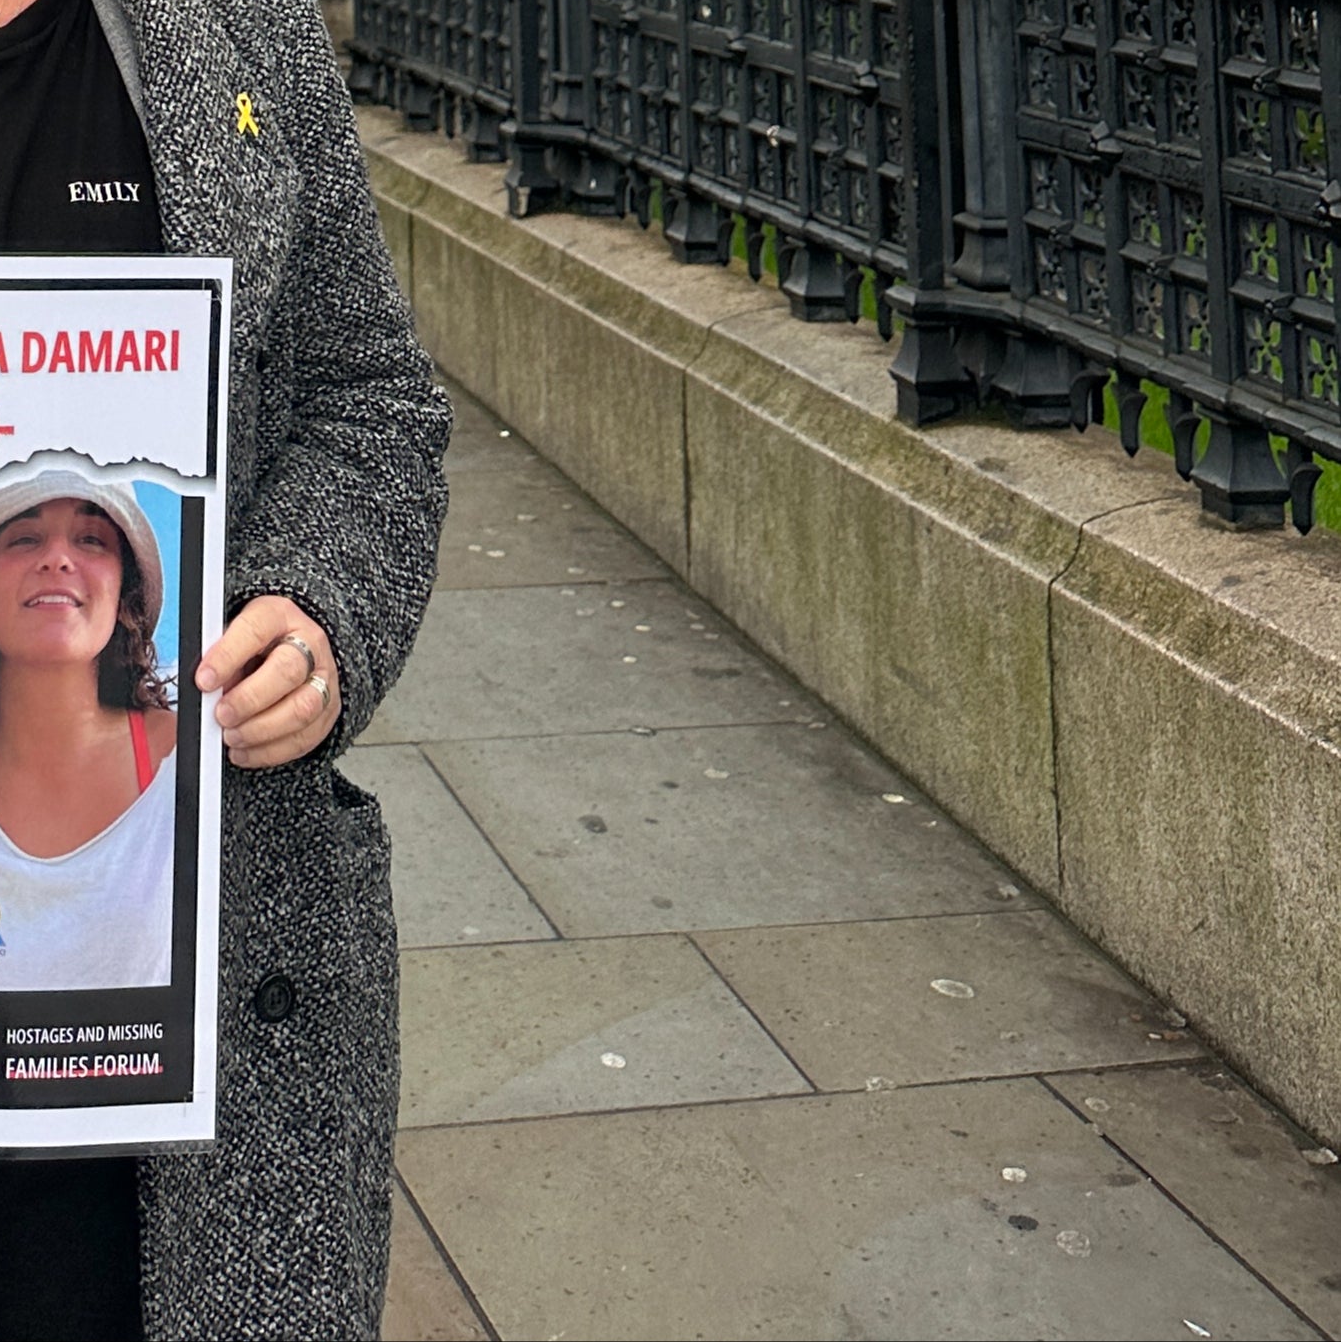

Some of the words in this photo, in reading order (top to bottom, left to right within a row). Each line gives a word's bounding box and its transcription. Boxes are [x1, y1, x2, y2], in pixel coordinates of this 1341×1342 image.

[67, 180, 140, 203] EMILY
[21, 329, 181, 373] DAMARI
[6, 1027, 74, 1045] HOSTAGES
[76, 1026, 105, 1043] AND
[107, 1023, 164, 1041] MISSING
[6, 1056, 89, 1079] FAMILIES
[93, 1053, 160, 1077] FORUM
